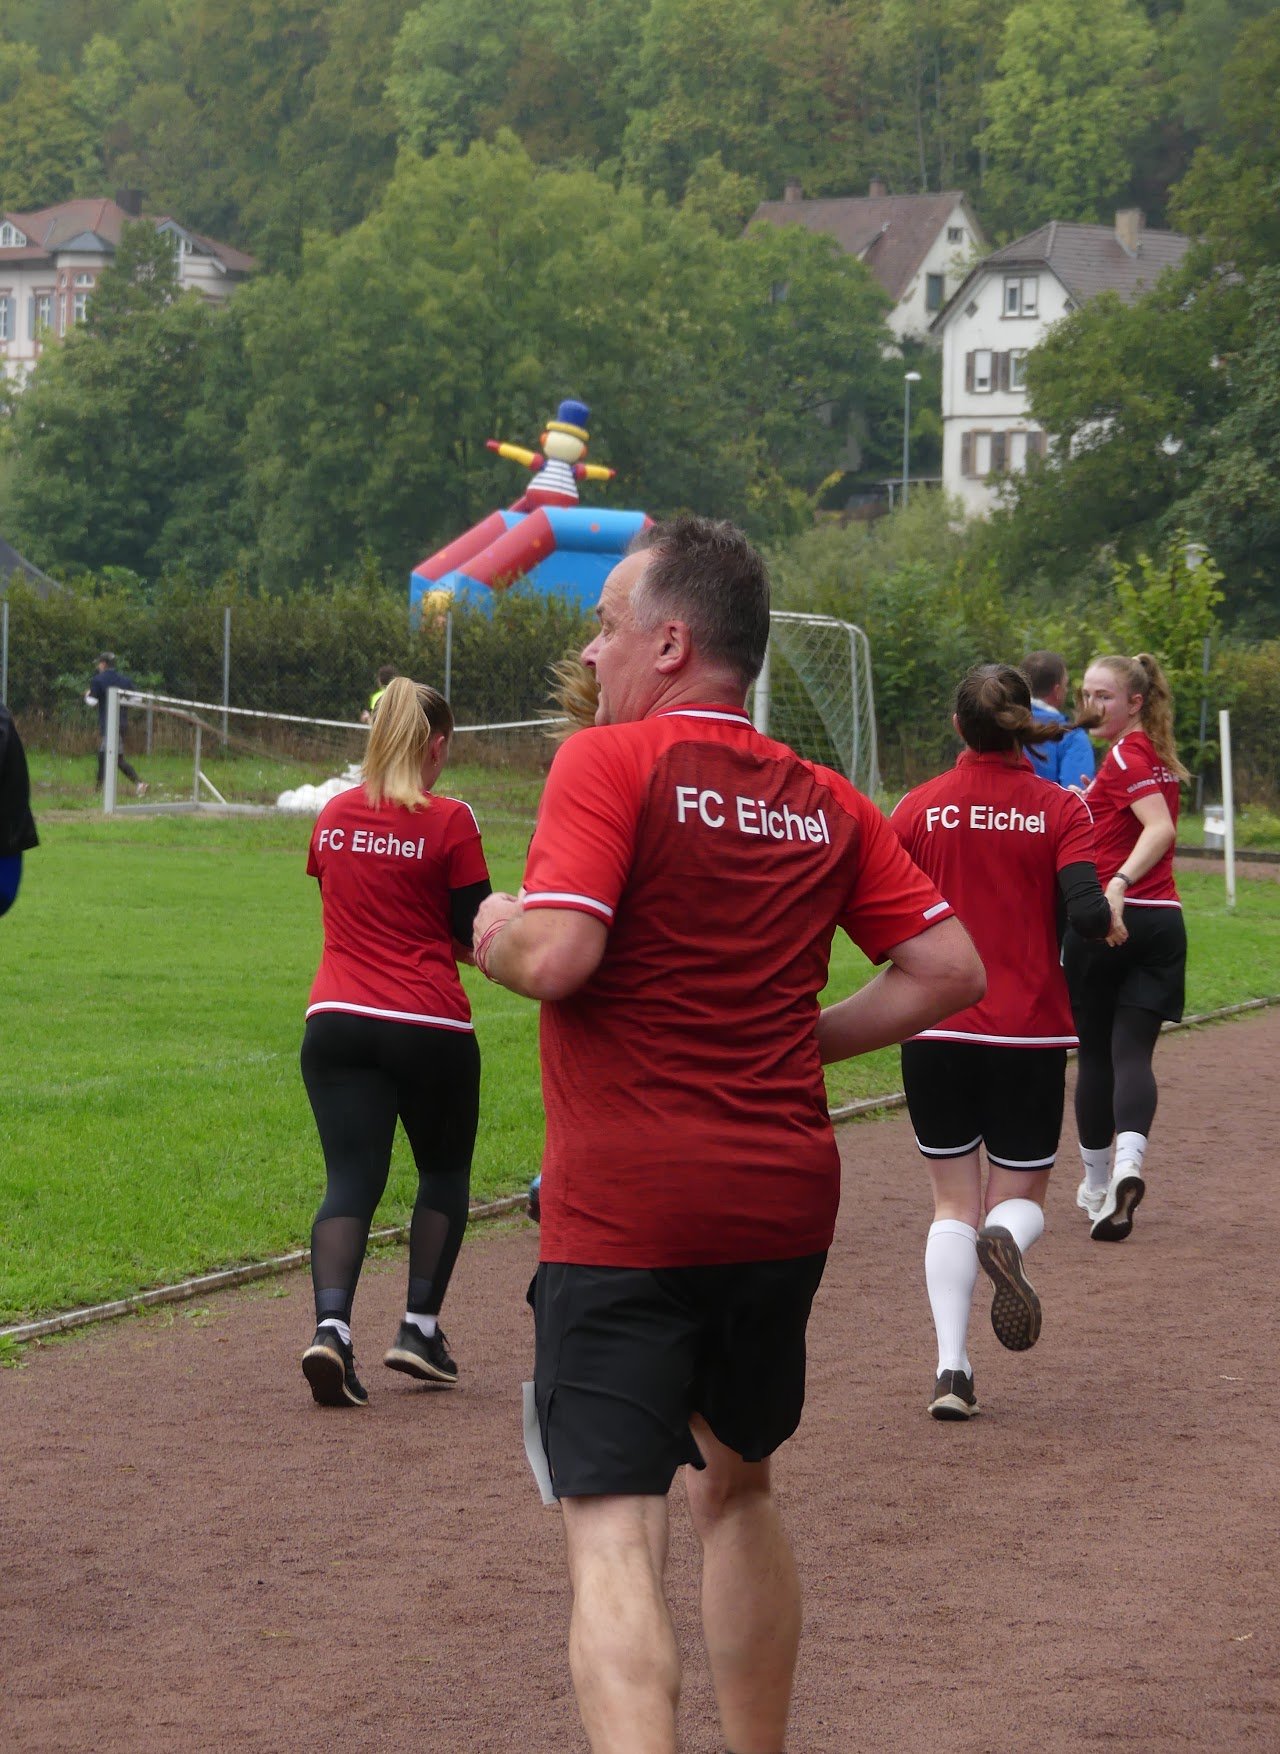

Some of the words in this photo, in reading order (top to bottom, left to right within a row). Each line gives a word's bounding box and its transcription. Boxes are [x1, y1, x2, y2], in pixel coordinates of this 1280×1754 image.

[676, 785, 726, 828] FC
[736, 795, 830, 845] Eichel
[926, 804, 960, 832] FC
[969, 805, 1045, 834] Eichel
[318, 828, 345, 852] FC
[351, 830, 425, 860] Eichel
